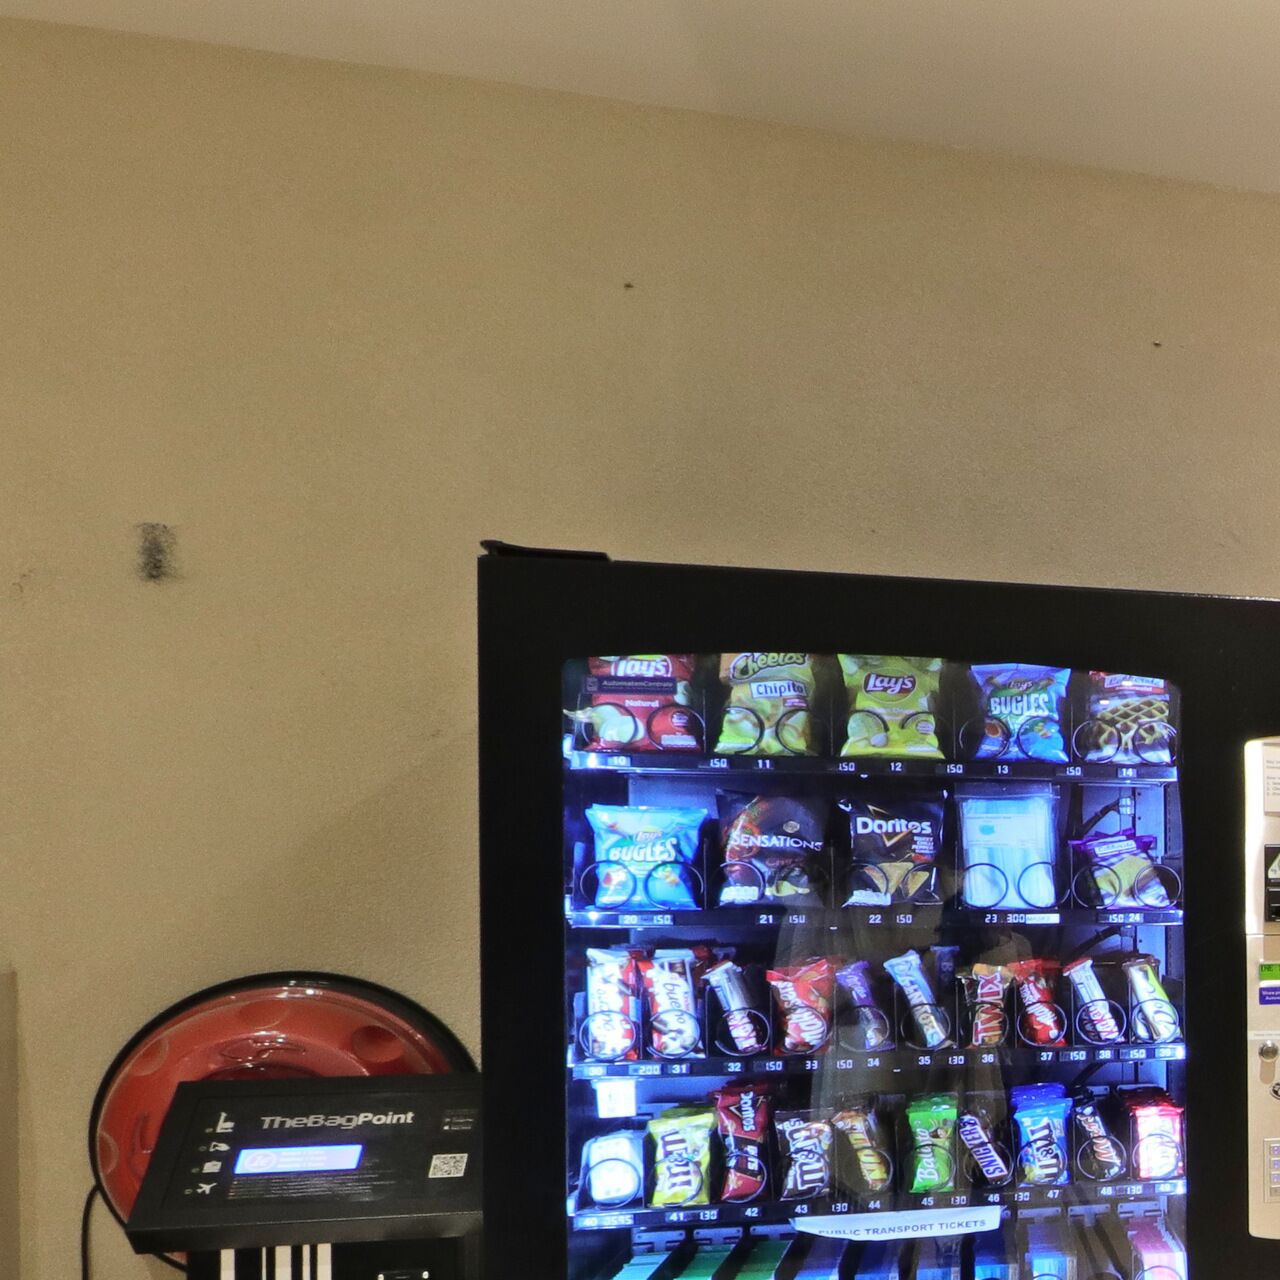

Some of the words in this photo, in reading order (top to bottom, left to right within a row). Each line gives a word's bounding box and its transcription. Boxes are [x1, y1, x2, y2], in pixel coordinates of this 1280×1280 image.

[866, 672, 916, 693] Lay's
[990, 694, 1050, 716] BUGLES
[757, 759, 771, 769] 11
[890, 762, 902, 772] 12
[997, 765, 1009, 775] 13
[1121, 768, 1133, 777] 14
[856, 817, 932, 834] Doritos
[731, 832, 824, 852] SENSATIONS
[609, 838, 678, 862] BUGLES
[759, 915, 773, 924] 21
[869, 914, 882, 924] 22
[662, 975, 687, 1024] bueno
[918, 1056, 931, 1065] 35
[981, 1054, 994, 1063] 36
[1040, 1051, 1053, 1060] 37
[728, 1062, 741, 1072] 32
[867, 1057, 880, 1067] 34
[740, 1090, 756, 1132] Doritos
[260, 1111, 416, 1129] TheBagPoint
[987, 1193, 1000, 1203] 46
[1047, 1189, 1059, 1199] 47
[868, 1200, 880, 1209] 44
[921, 1196, 934, 1206] 45
[745, 1207, 758, 1217] 42
[795, 1204, 808, 1214] 43
[863, 1222, 934, 1235] TRANSPORT
[938, 1219, 987, 1230] TICKETS
